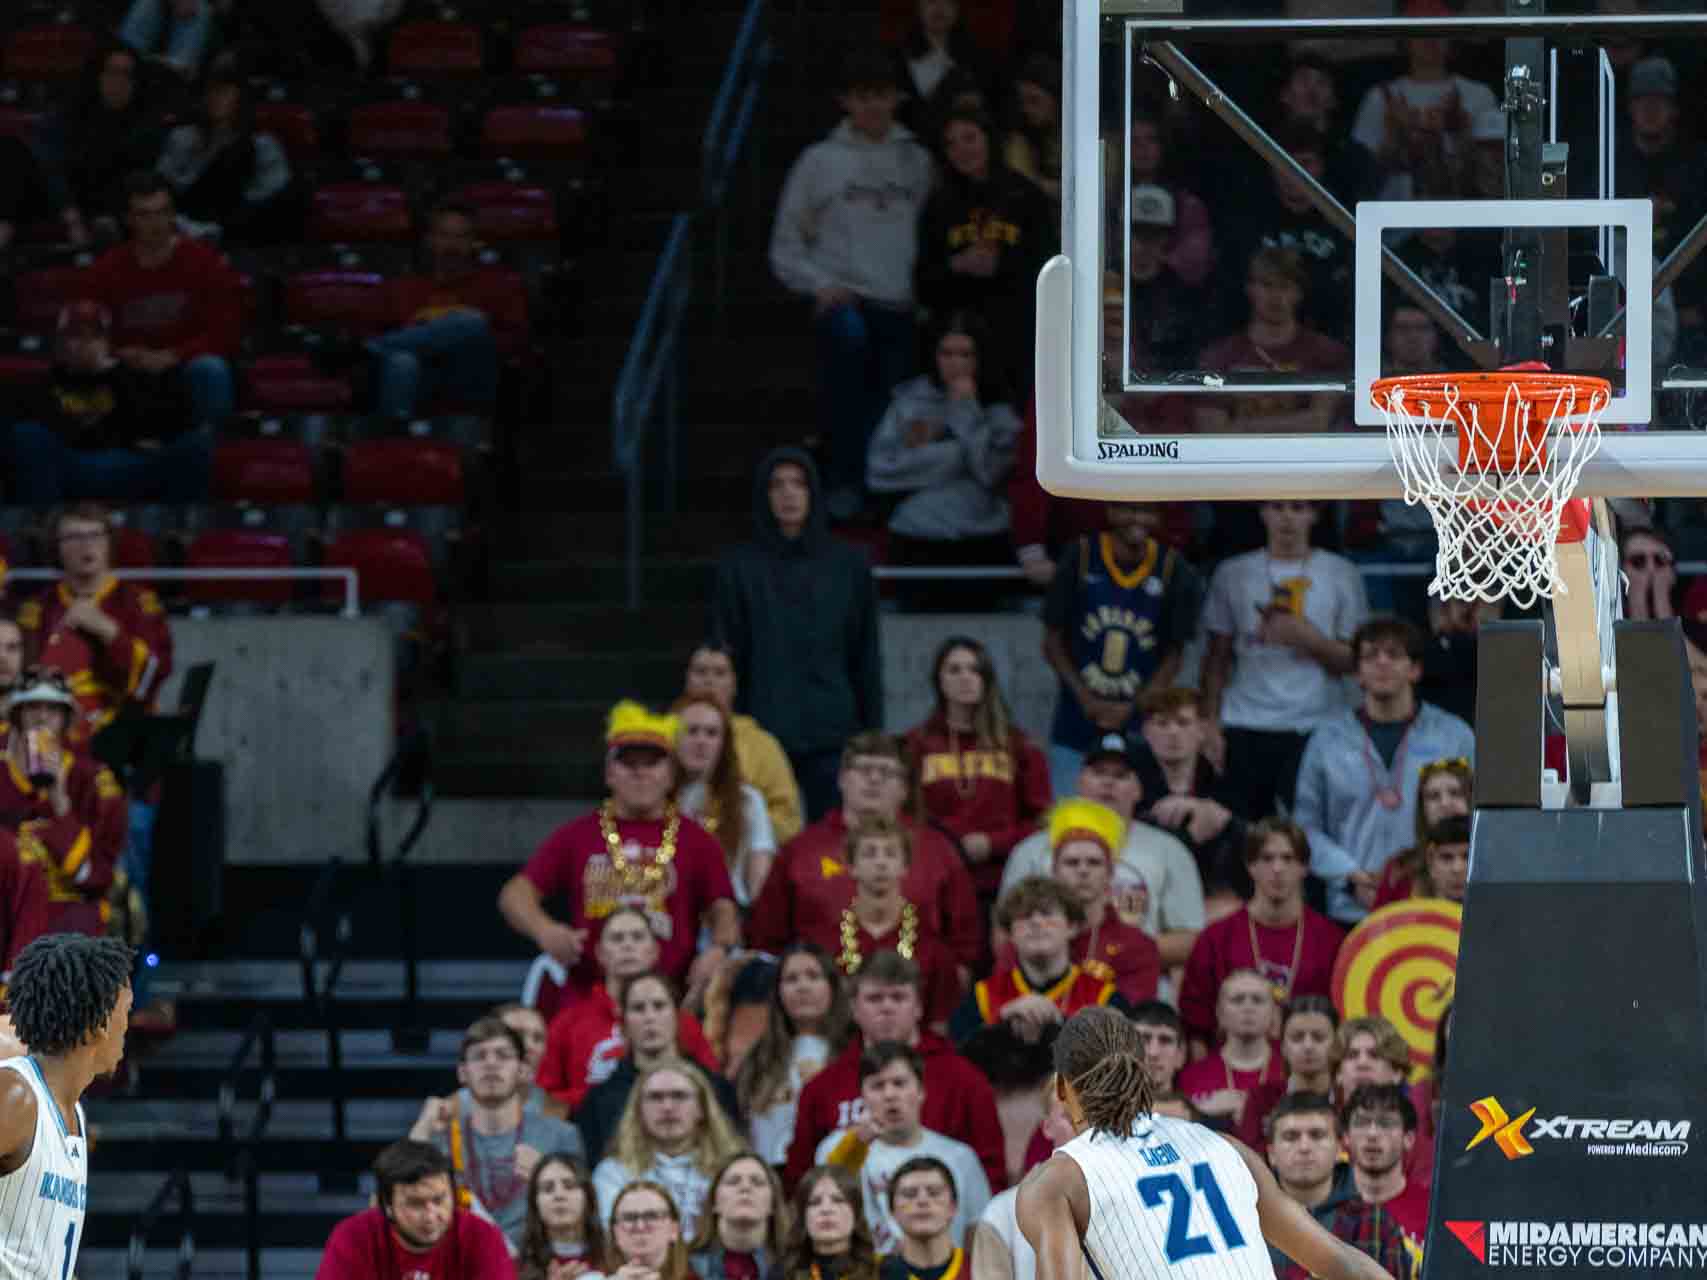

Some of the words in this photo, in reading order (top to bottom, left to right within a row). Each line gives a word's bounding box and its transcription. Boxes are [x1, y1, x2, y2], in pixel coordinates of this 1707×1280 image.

[1097, 440, 1179, 460] SPALDING
[1529, 1115, 1692, 1140] XTREAM
[1587, 1143, 1616, 1156] POWERED
[1616, 1143, 1625, 1156] BY
[1625, 1141, 1689, 1156] Mediacom
[1137, 1162, 1247, 1264] 21
[1489, 1221, 1707, 1247] MIDAMERICAN
[1488, 1245, 1582, 1267] ENERGY
[1588, 1246, 1707, 1268] COMPANY
